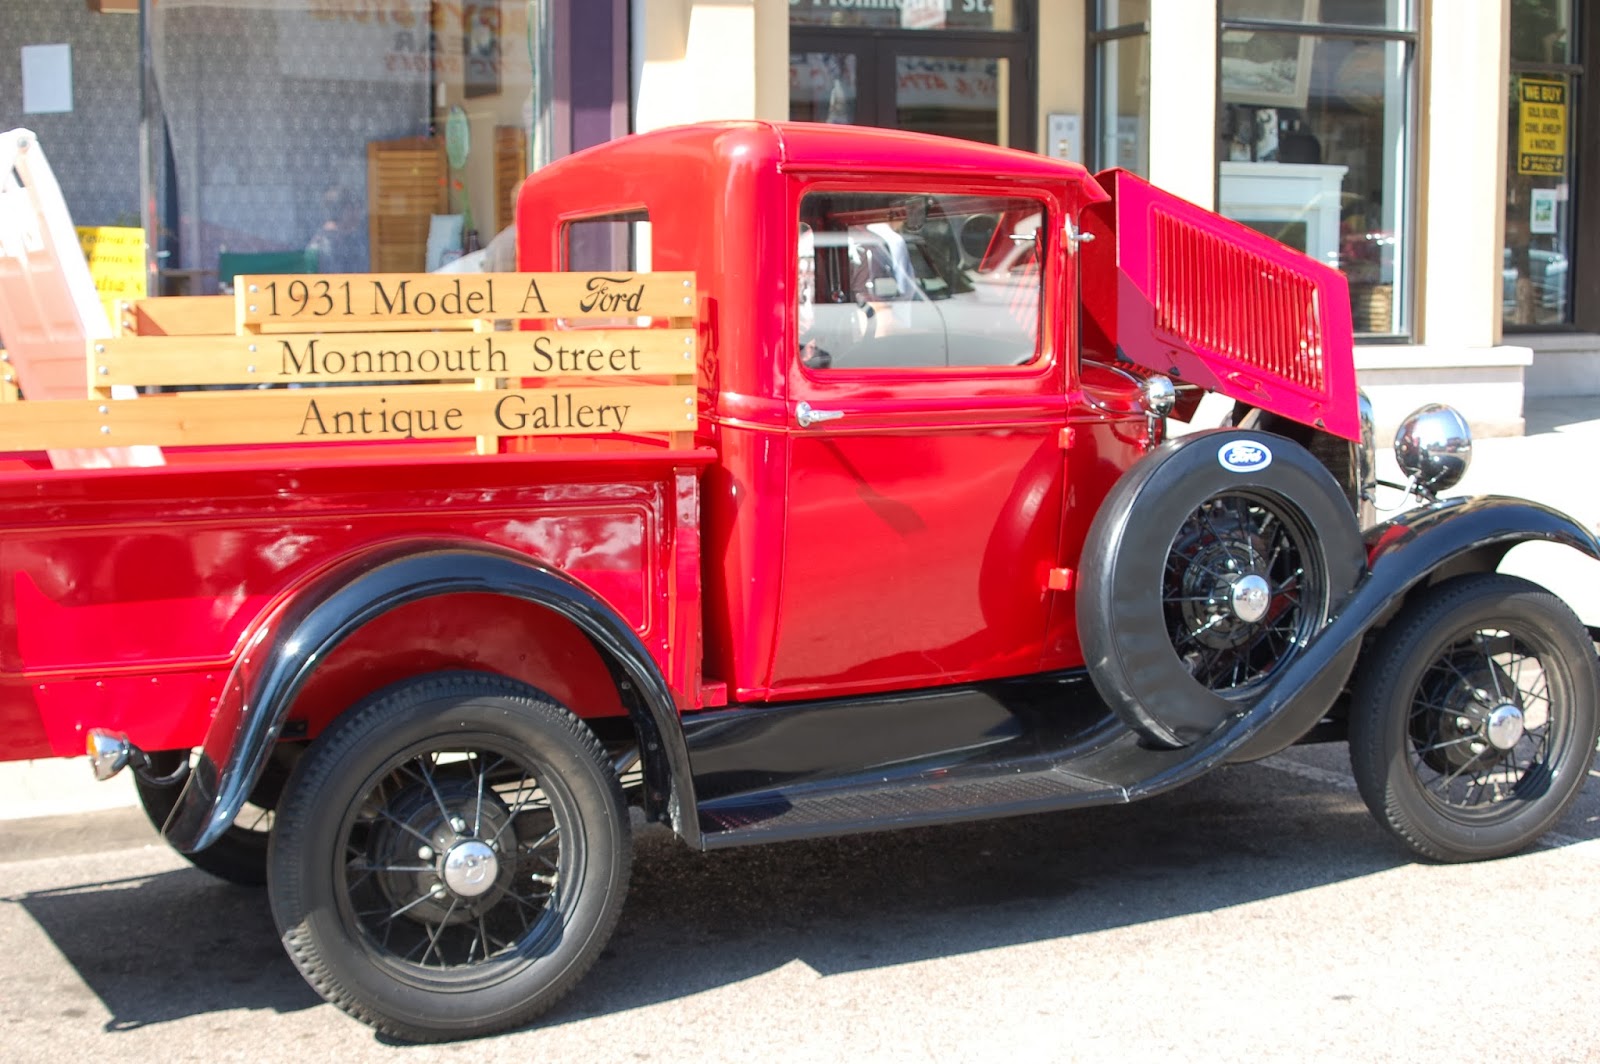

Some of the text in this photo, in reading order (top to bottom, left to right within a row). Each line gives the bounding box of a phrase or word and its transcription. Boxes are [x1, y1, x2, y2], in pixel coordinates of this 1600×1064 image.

[1525, 85, 1562, 103] WE BUY
[265, 276, 645, 316] 1931 Model A Ford
[278, 336, 641, 375] Monmouth Street
[296, 392, 631, 440] Antique Gallery
